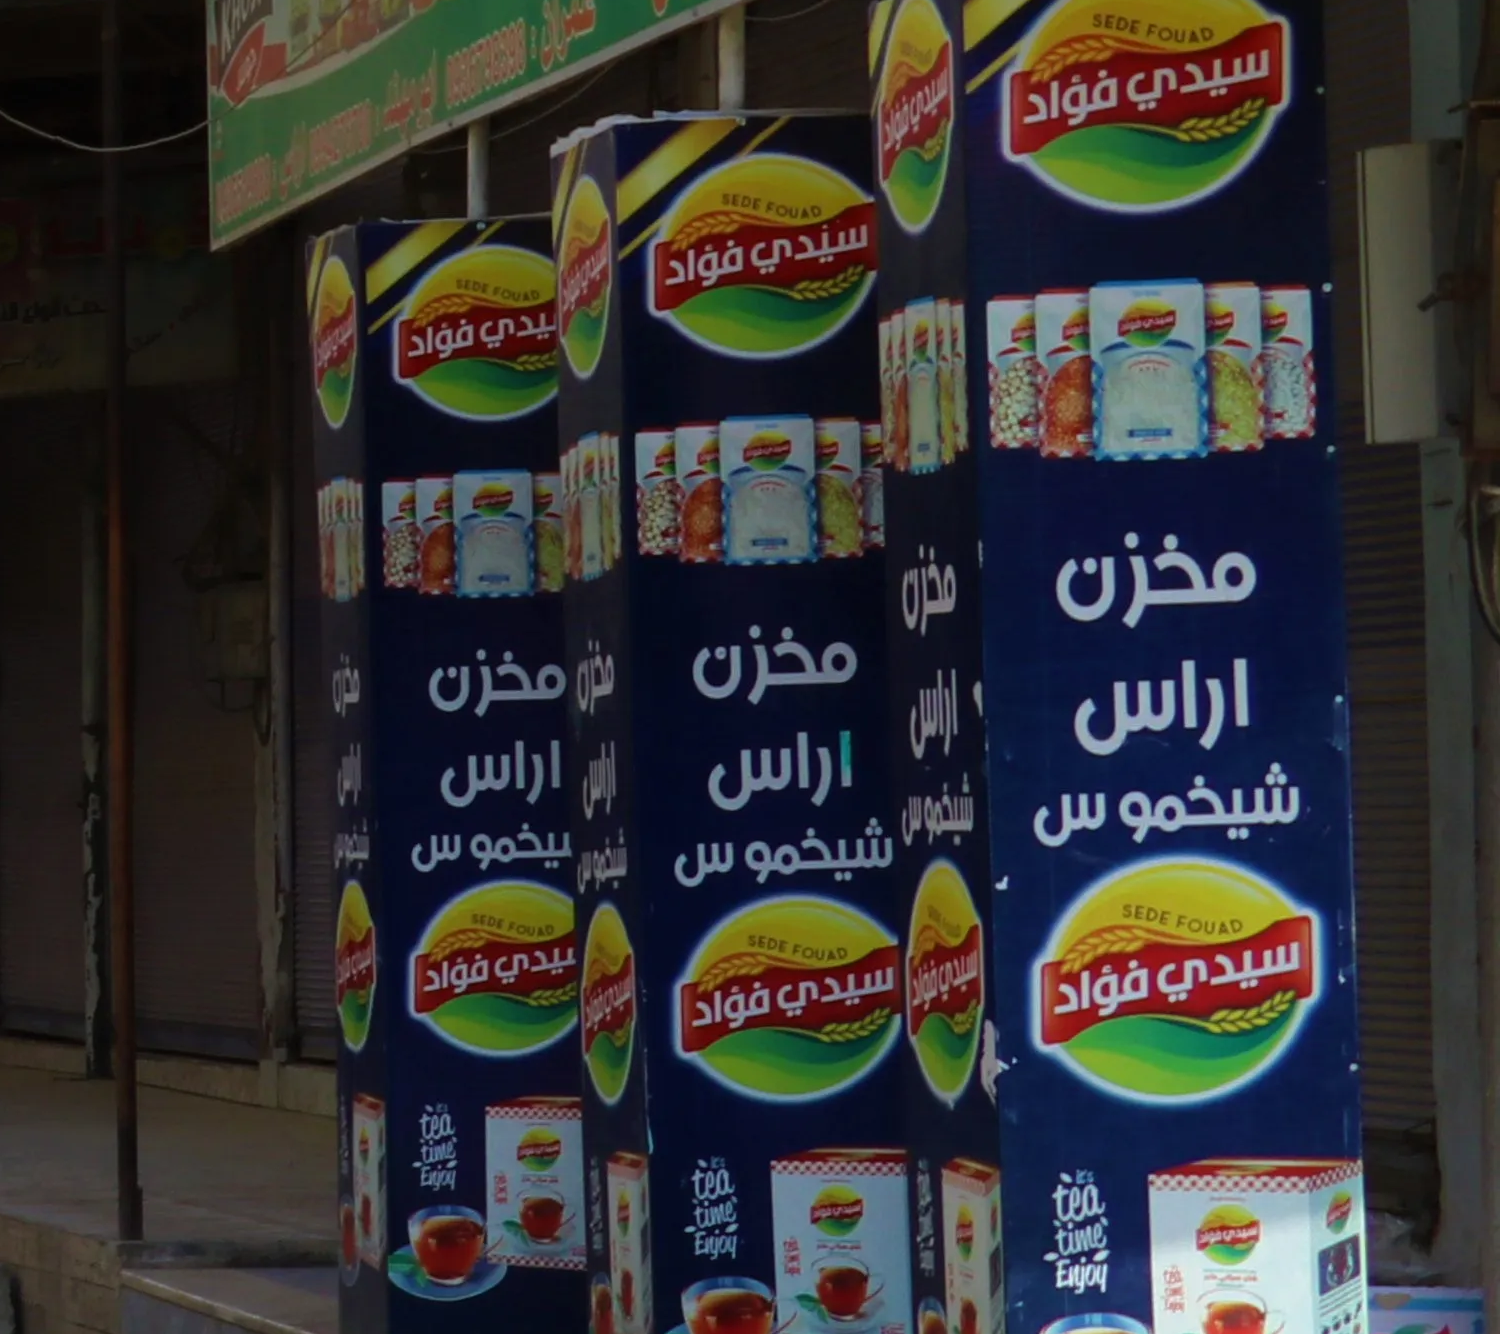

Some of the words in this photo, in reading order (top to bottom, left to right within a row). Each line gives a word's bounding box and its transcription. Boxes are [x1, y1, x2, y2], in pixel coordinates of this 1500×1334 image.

[1093, 13, 1139, 36] SEDE
[1147, 23, 1215, 44] FOUAD
[1022, 69, 1118, 127] فؤاد
[1126, 48, 1270, 111] سيدي
[721, 192, 761, 211] SEDE
[765, 201, 822, 219] FOUAD
[663, 239, 744, 287] فؤاد
[750, 223, 869, 275] سيدي
[455, 278, 489, 296] SEDE
[492, 285, 541, 302] FOUAD
[407, 318, 474, 360] فؤاد
[900, 544, 957, 636] مخزن
[1055, 531, 1258, 629] مخزن
[428, 649, 567, 717] مخزن
[576, 640, 616, 716] مخزن
[692, 625, 859, 706] مخزن
[908, 667, 959, 761] اراس
[1073, 657, 1252, 756] اراس
[439, 740, 562, 808] اراس
[582, 740, 617, 820] اراس
[707, 730, 853, 812] اراس
[471, 913, 506, 928] SEDE
[508, 919, 556, 937] FOUAD
[1121, 903, 1173, 927] SEDE
[1177, 913, 1244, 937] FOUAD
[747, 934, 789, 954] SEDE
[792, 943, 848, 962] FOUAD
[1156, 938, 1302, 1004] سيدي
[422, 958, 490, 994] فؤاد
[777, 962, 896, 1016] سيدي
[1054, 959, 1149, 1018] فؤاد
[690, 983, 771, 1030] فؤاد
[691, 1163, 736, 1200] tea
[1052, 1181, 1105, 1223] tea
[692, 1199, 737, 1229] time
[693, 1229, 738, 1260] Enjoy
[1055, 1223, 1106, 1257] time
[1054, 1256, 1109, 1294] Enjoy
